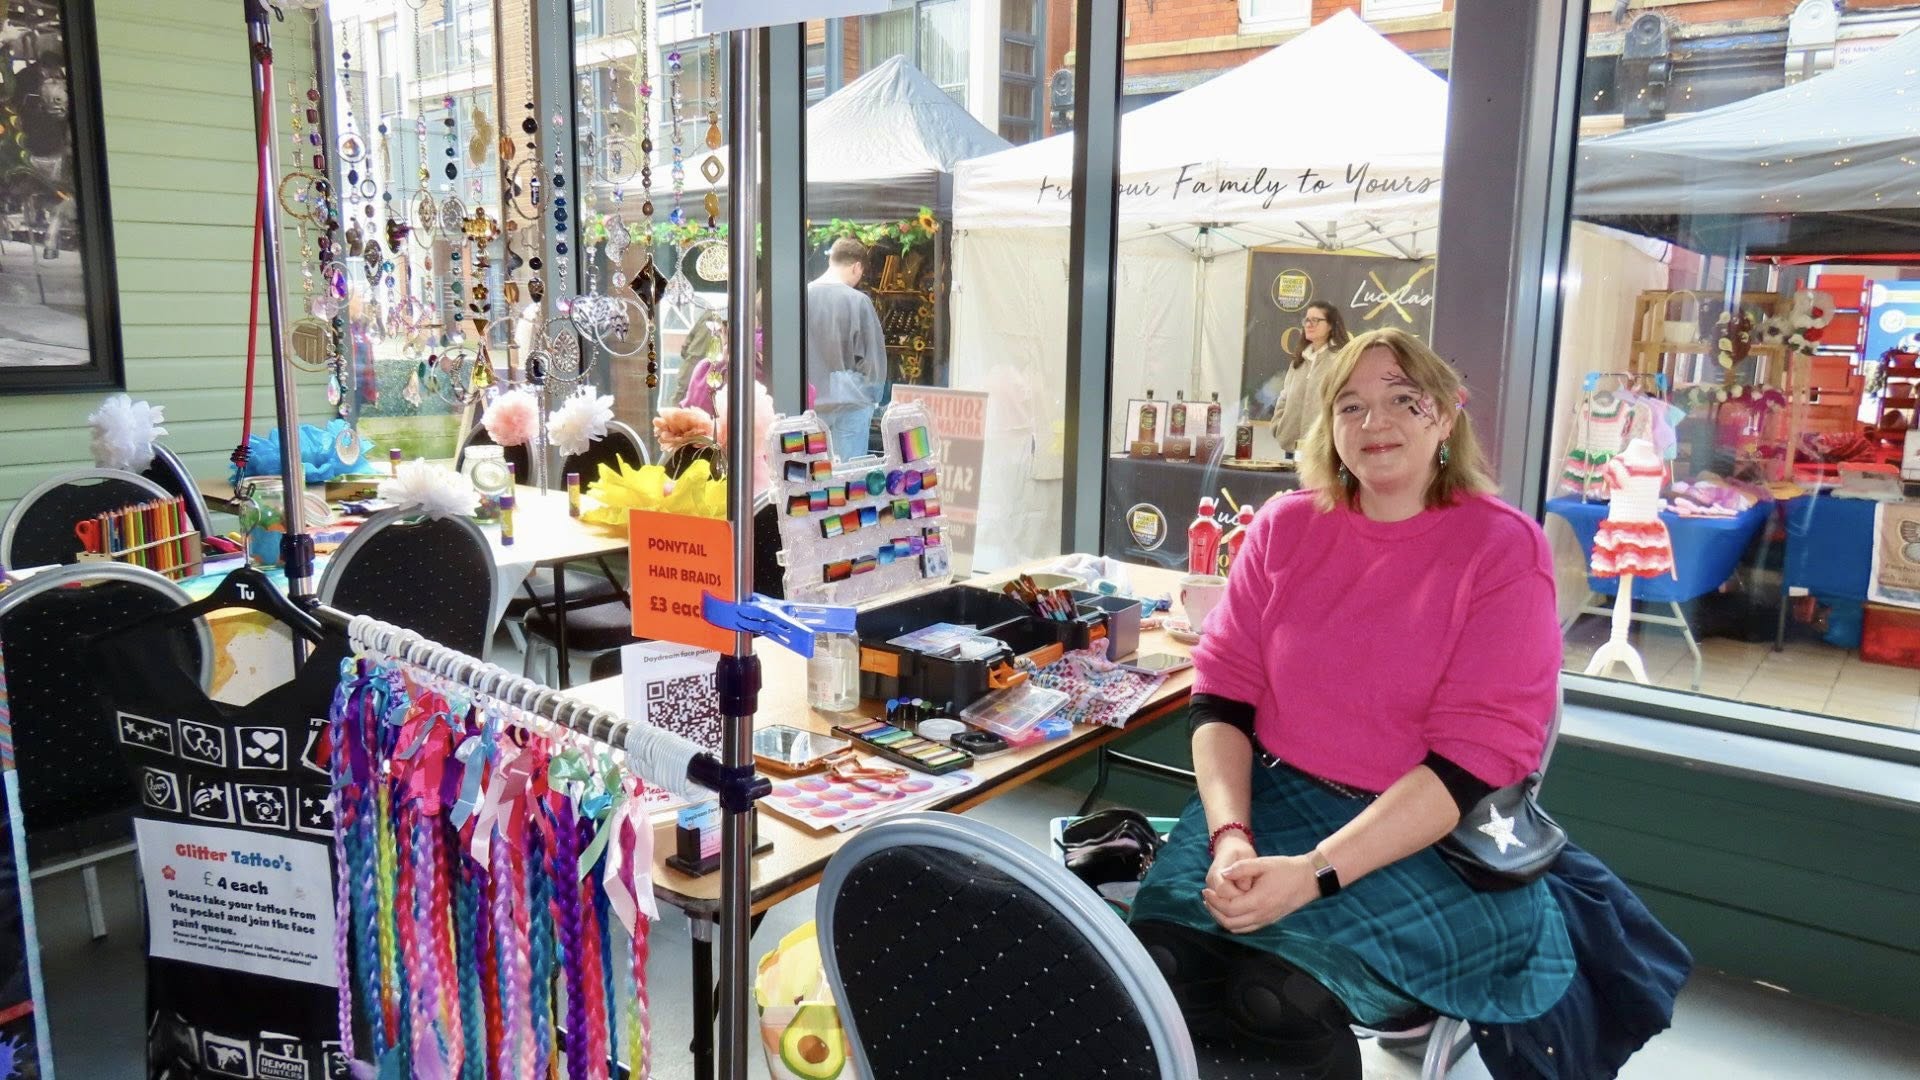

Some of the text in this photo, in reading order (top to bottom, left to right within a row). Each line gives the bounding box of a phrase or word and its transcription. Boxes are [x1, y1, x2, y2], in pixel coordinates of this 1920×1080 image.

[1118, 180, 1160, 197] our
[1297, 168, 1334, 193] to
[1346, 162, 1440, 203] Yours
[648, 537, 707, 557] PONYTAIL
[649, 564, 722, 587] HAIR BRAIDS
[235, 583, 255, 601] Tu
[650, 595, 702, 618] £3 eac
[643, 653, 681, 664] Daydream
[175, 844, 293, 871] Glitter Tattoo's
[217, 877, 227, 889] 4
[231, 881, 269, 895] each
[168, 889, 316, 920] Please take your tattoo from
[171, 903, 316, 935] the pocket and join the face
[172, 919, 237, 936] paint queue.
[261, 1057, 303, 1072] DEMON
[261, 1065, 303, 1080] HUNTERS
